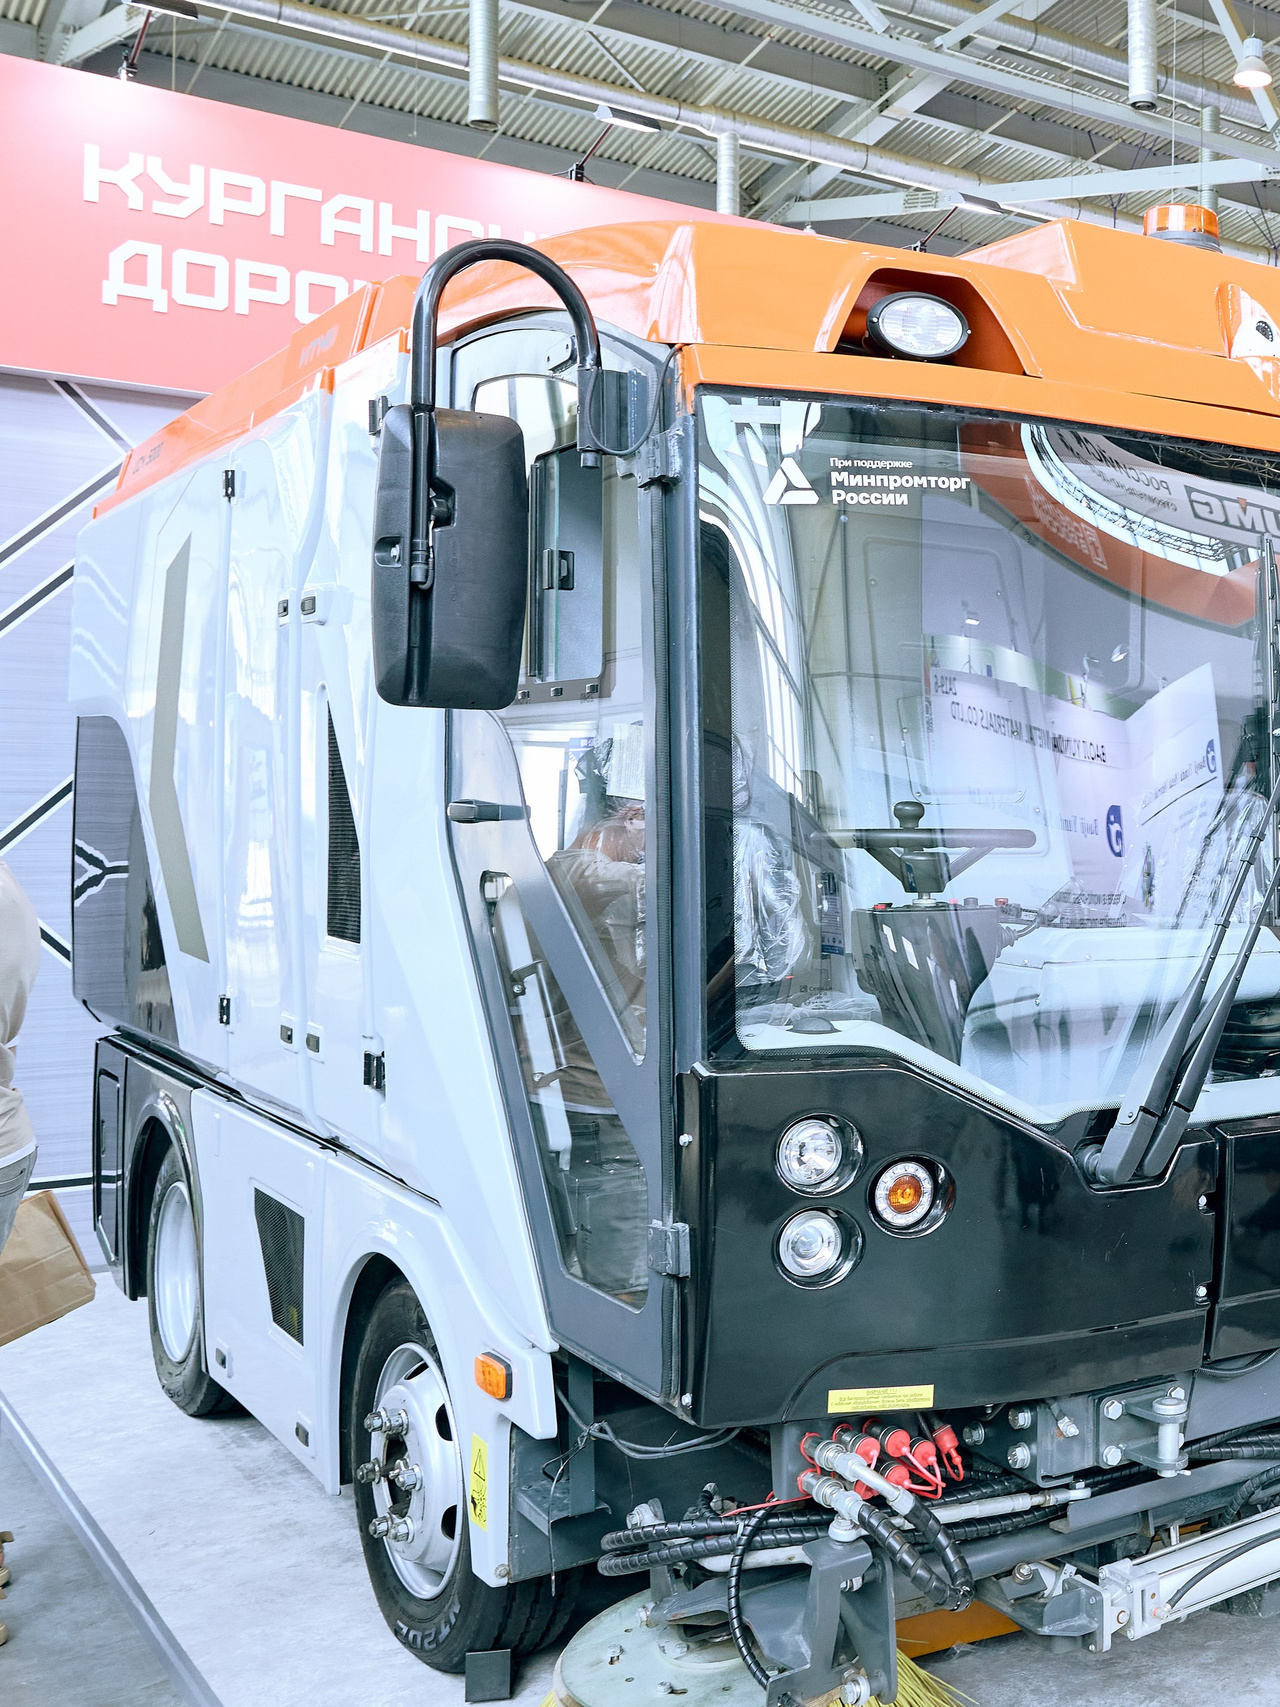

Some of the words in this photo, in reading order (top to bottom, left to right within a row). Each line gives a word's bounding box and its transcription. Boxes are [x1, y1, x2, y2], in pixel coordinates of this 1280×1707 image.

[83, 143, 549, 264] КУРГАНС
[102, 240, 369, 325] ДОРО
[830, 457, 852, 468] При
[854, 458, 913, 470] поддержке
[831, 471, 971, 492] Минпромторг
[832, 489, 909, 506] России
